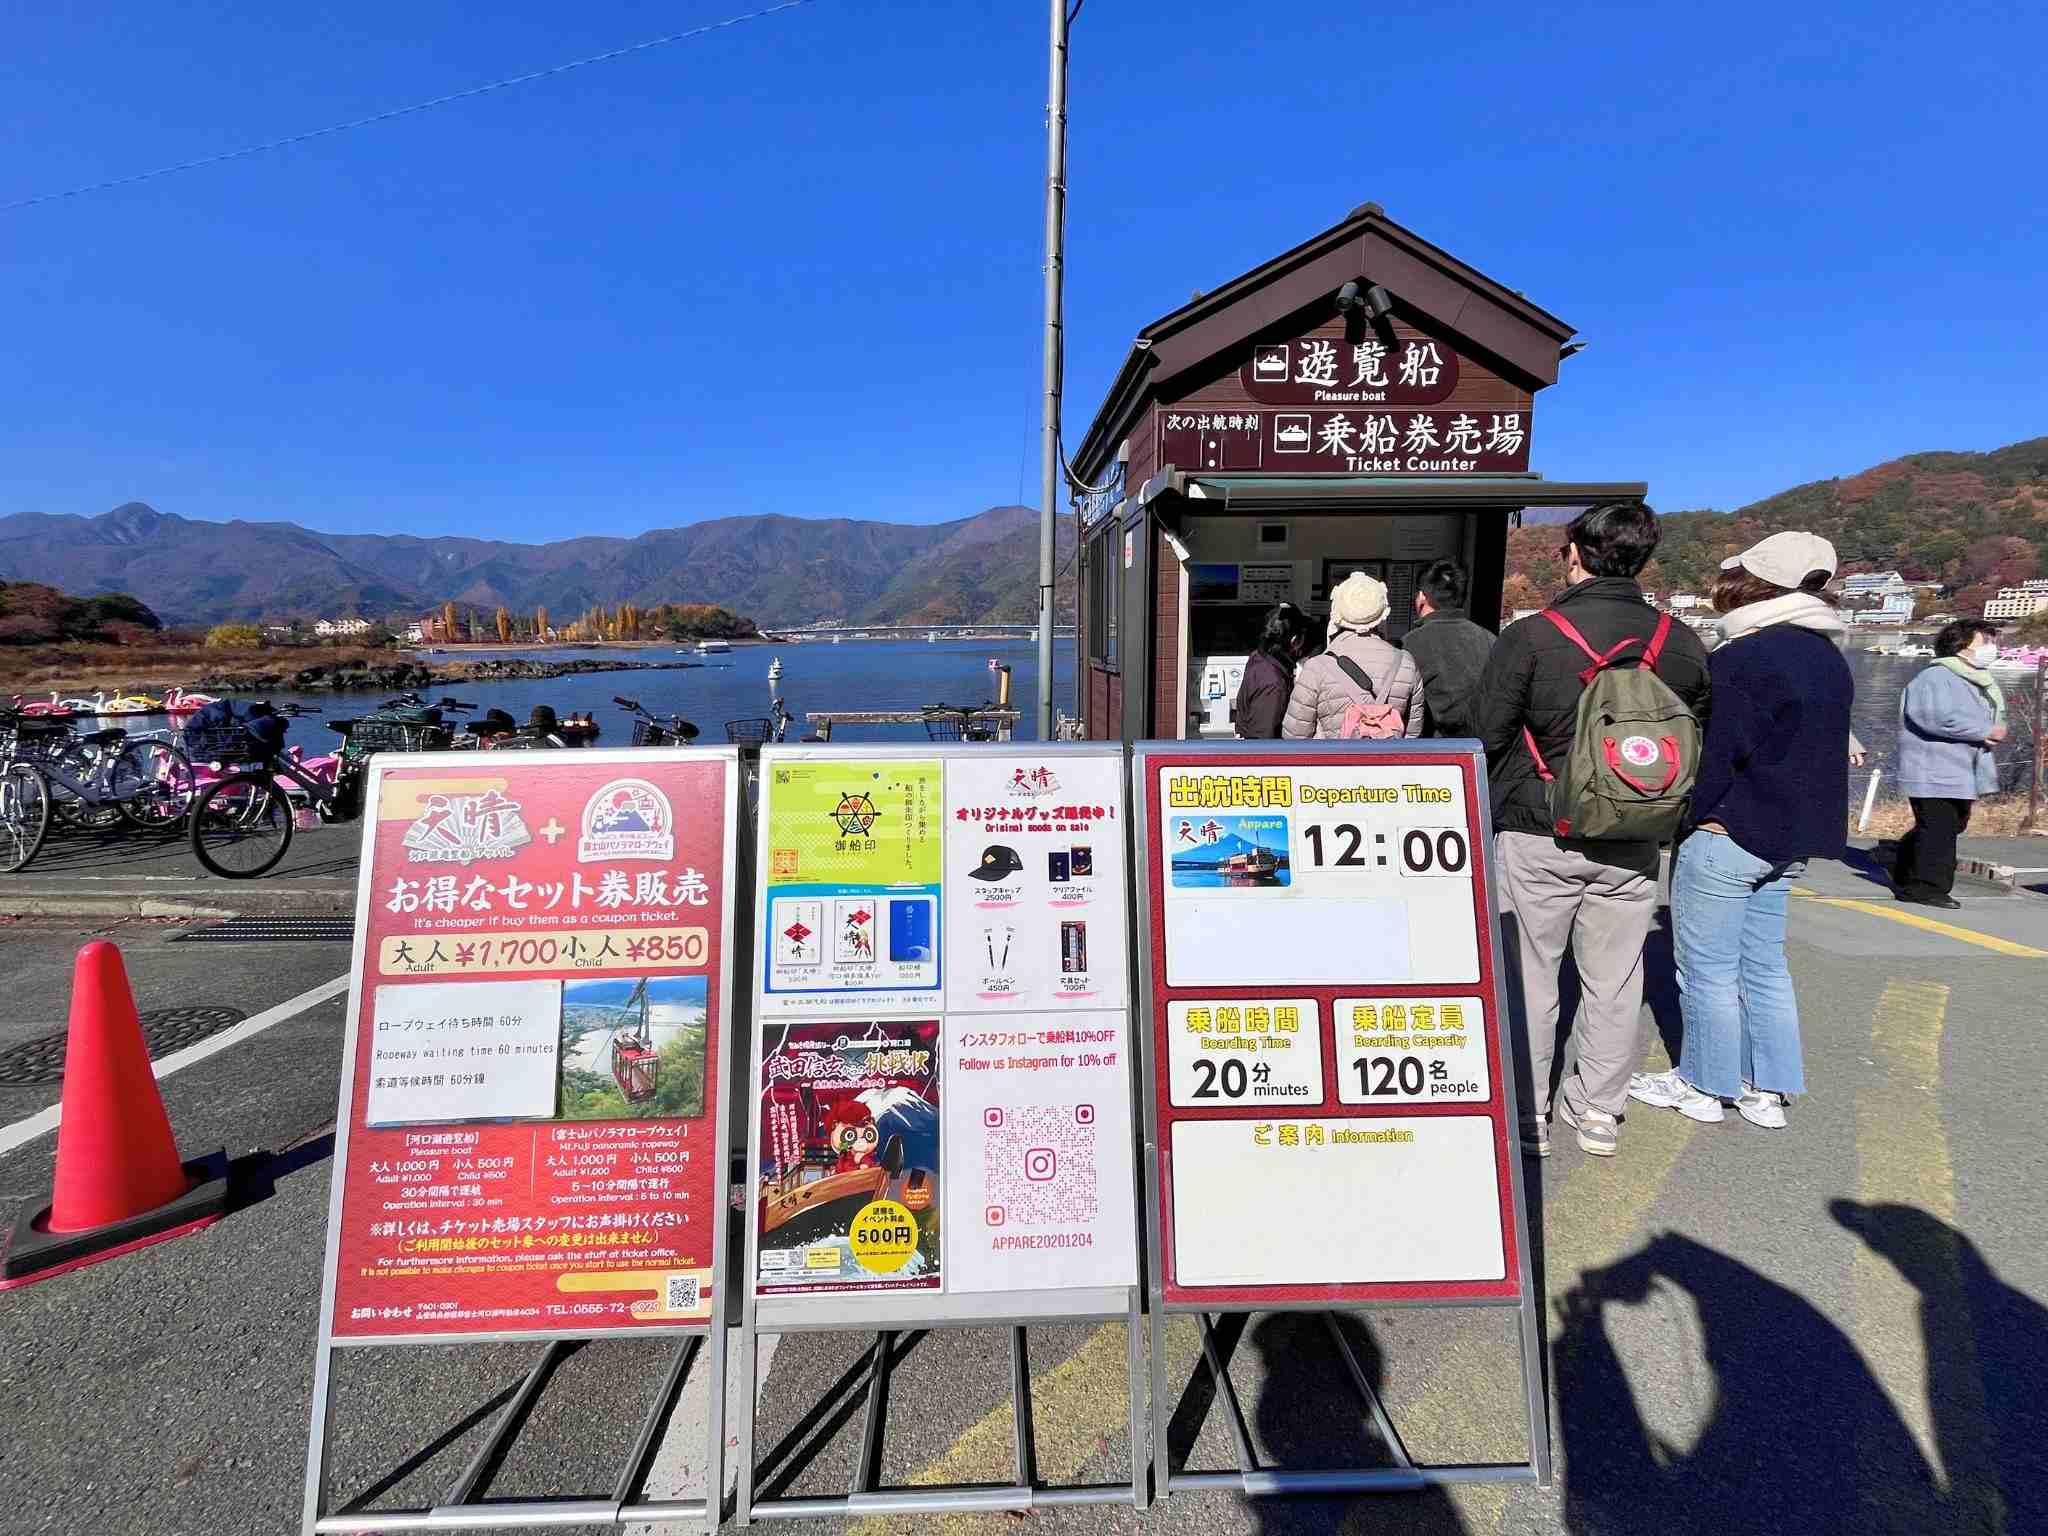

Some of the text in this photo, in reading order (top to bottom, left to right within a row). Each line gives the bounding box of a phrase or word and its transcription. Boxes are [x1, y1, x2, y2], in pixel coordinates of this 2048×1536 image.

[1295, 341, 1443, 387] 遊覧船
[1315, 390, 1386, 401] Pleasure boat
[1167, 414, 1259, 430] 次の出航時刻
[1316, 413, 1524, 456] 乗船券売場
[1346, 457, 1477, 471] Ticket Counter
[1170, 776, 1452, 808] 出航時間 Departure Time
[985, 823, 1023, 833] Original
[1028, 823, 1052, 832] goods
[1070, 823, 1089, 832] sale
[1238, 818, 1284, 832] Appare
[1304, 823, 1467, 873] 12:00
[385, 868, 709, 913] お得なセット券販売
[415, 918, 432, 928] It's
[435, 917, 483, 929] cheaper
[489, 916, 498, 926] if
[502, 916, 524, 927] buy
[529, 914, 559, 925] them
[562, 915, 577, 924] as
[592, 913, 637, 925] coupon
[640, 911, 680, 922] ticket.
[456, 938, 557, 967] ¥1,700
[626, 934, 703, 962] ¥850
[406, 964, 435, 972] Adult
[575, 958, 603, 968] Child
[500, 1016, 522, 1027] 60分
[1187, 1007, 1300, 1033] 乗船時間
[1352, 1004, 1465, 1031] 乗船定員
[1201, 1035, 1291, 1051] Boarding Time
[1354, 1034, 1467, 1050] Boarding Capacity
[376, 1043, 554, 1061] Ropeway waiting time 60 minutes
[959, 1052, 1118, 1071] Follow us Instagram for 10% off
[1254, 1082, 1309, 1096] minutes
[1431, 1080, 1479, 1097] people
[1253, 1124, 1414, 1146] ご案内 Information
[410, 1146, 473, 1156] Pleasure boat
[592, 1142, 639, 1150] panoramic
[642, 1140, 680, 1149] ropeway
[369, 1160, 391, 1172] 大人
[453, 1158, 473, 1169] 小人
[545, 1155, 568, 1167] 大人
[630, 1152, 651, 1163] 小人
[376, 1174, 399, 1183] Adult
[457, 1171, 481, 1180] Child
[552, 1168, 577, 1177] Adult
[636, 1165, 658, 1174] Child
[383, 1198, 503, 1210] Operation interval 30 min
[551, 1195, 596, 1205] Operation
[598, 1194, 634, 1203] interval
[649, 1192, 660, 1200] to
[662, 1191, 673, 1200] 10
[674, 1191, 689, 1199] min
[857, 1226, 911, 1244] 500円
[991, 1232, 1094, 1250] APPARE20201204
[378, 1257, 394, 1266] For
[351, 1306, 413, 1319] お問い合わせ
